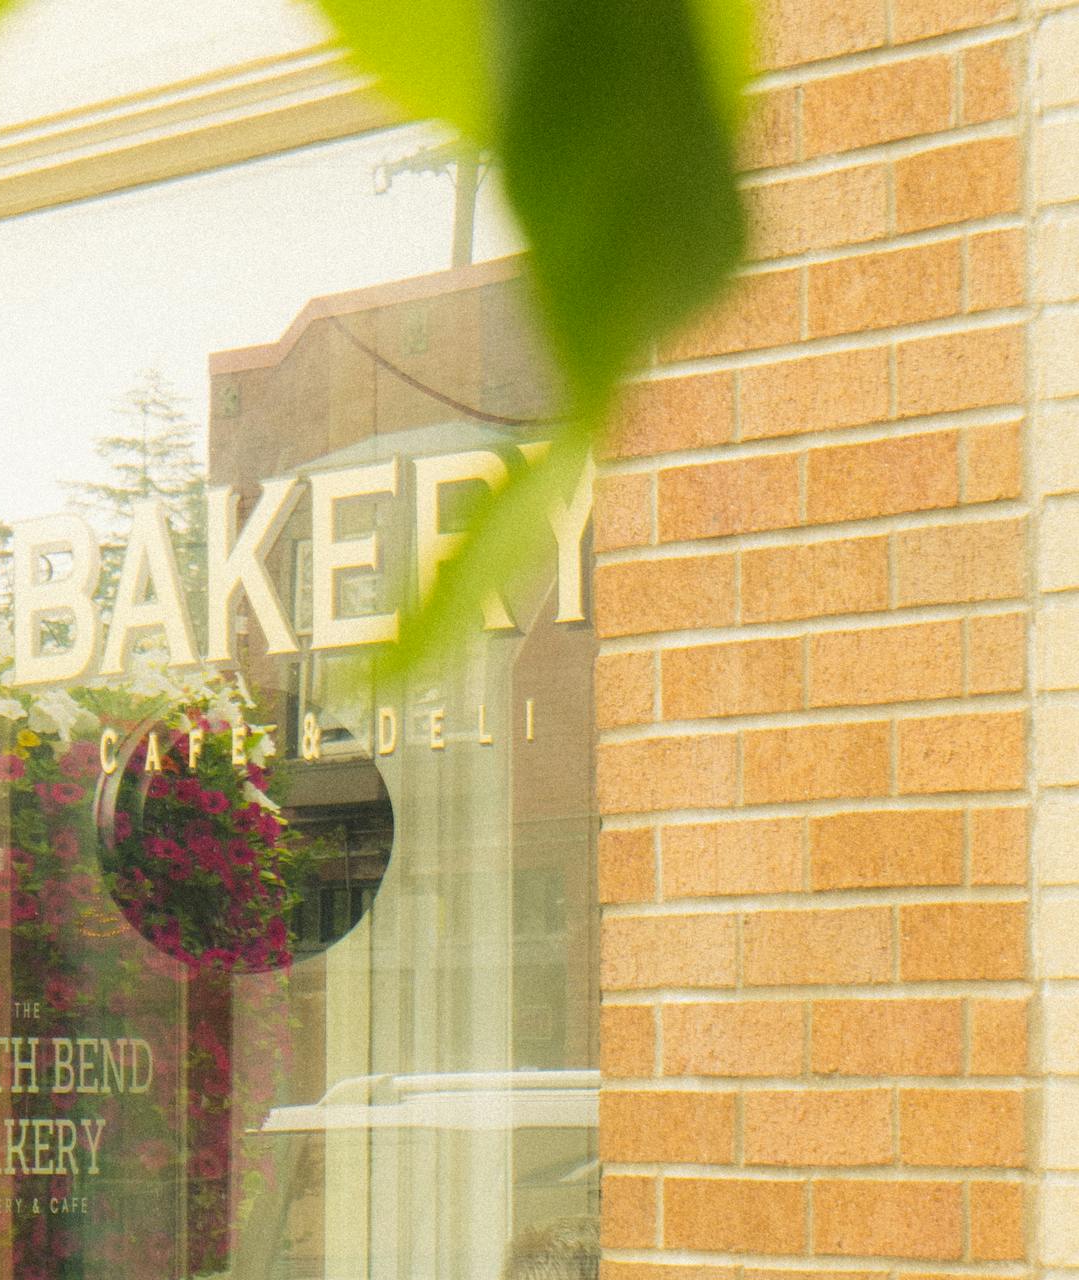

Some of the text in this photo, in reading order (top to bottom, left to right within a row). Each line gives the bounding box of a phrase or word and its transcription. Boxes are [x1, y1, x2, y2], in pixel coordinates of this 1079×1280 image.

[302, 712, 321, 760] &
[378, 700, 535, 756] DELI
[15, 1002, 41, 1019] THE
[52, 1038, 154, 1094] BEND
[31, 1198, 41, 1215] &
[49, 1197, 88, 1215] CAFE
